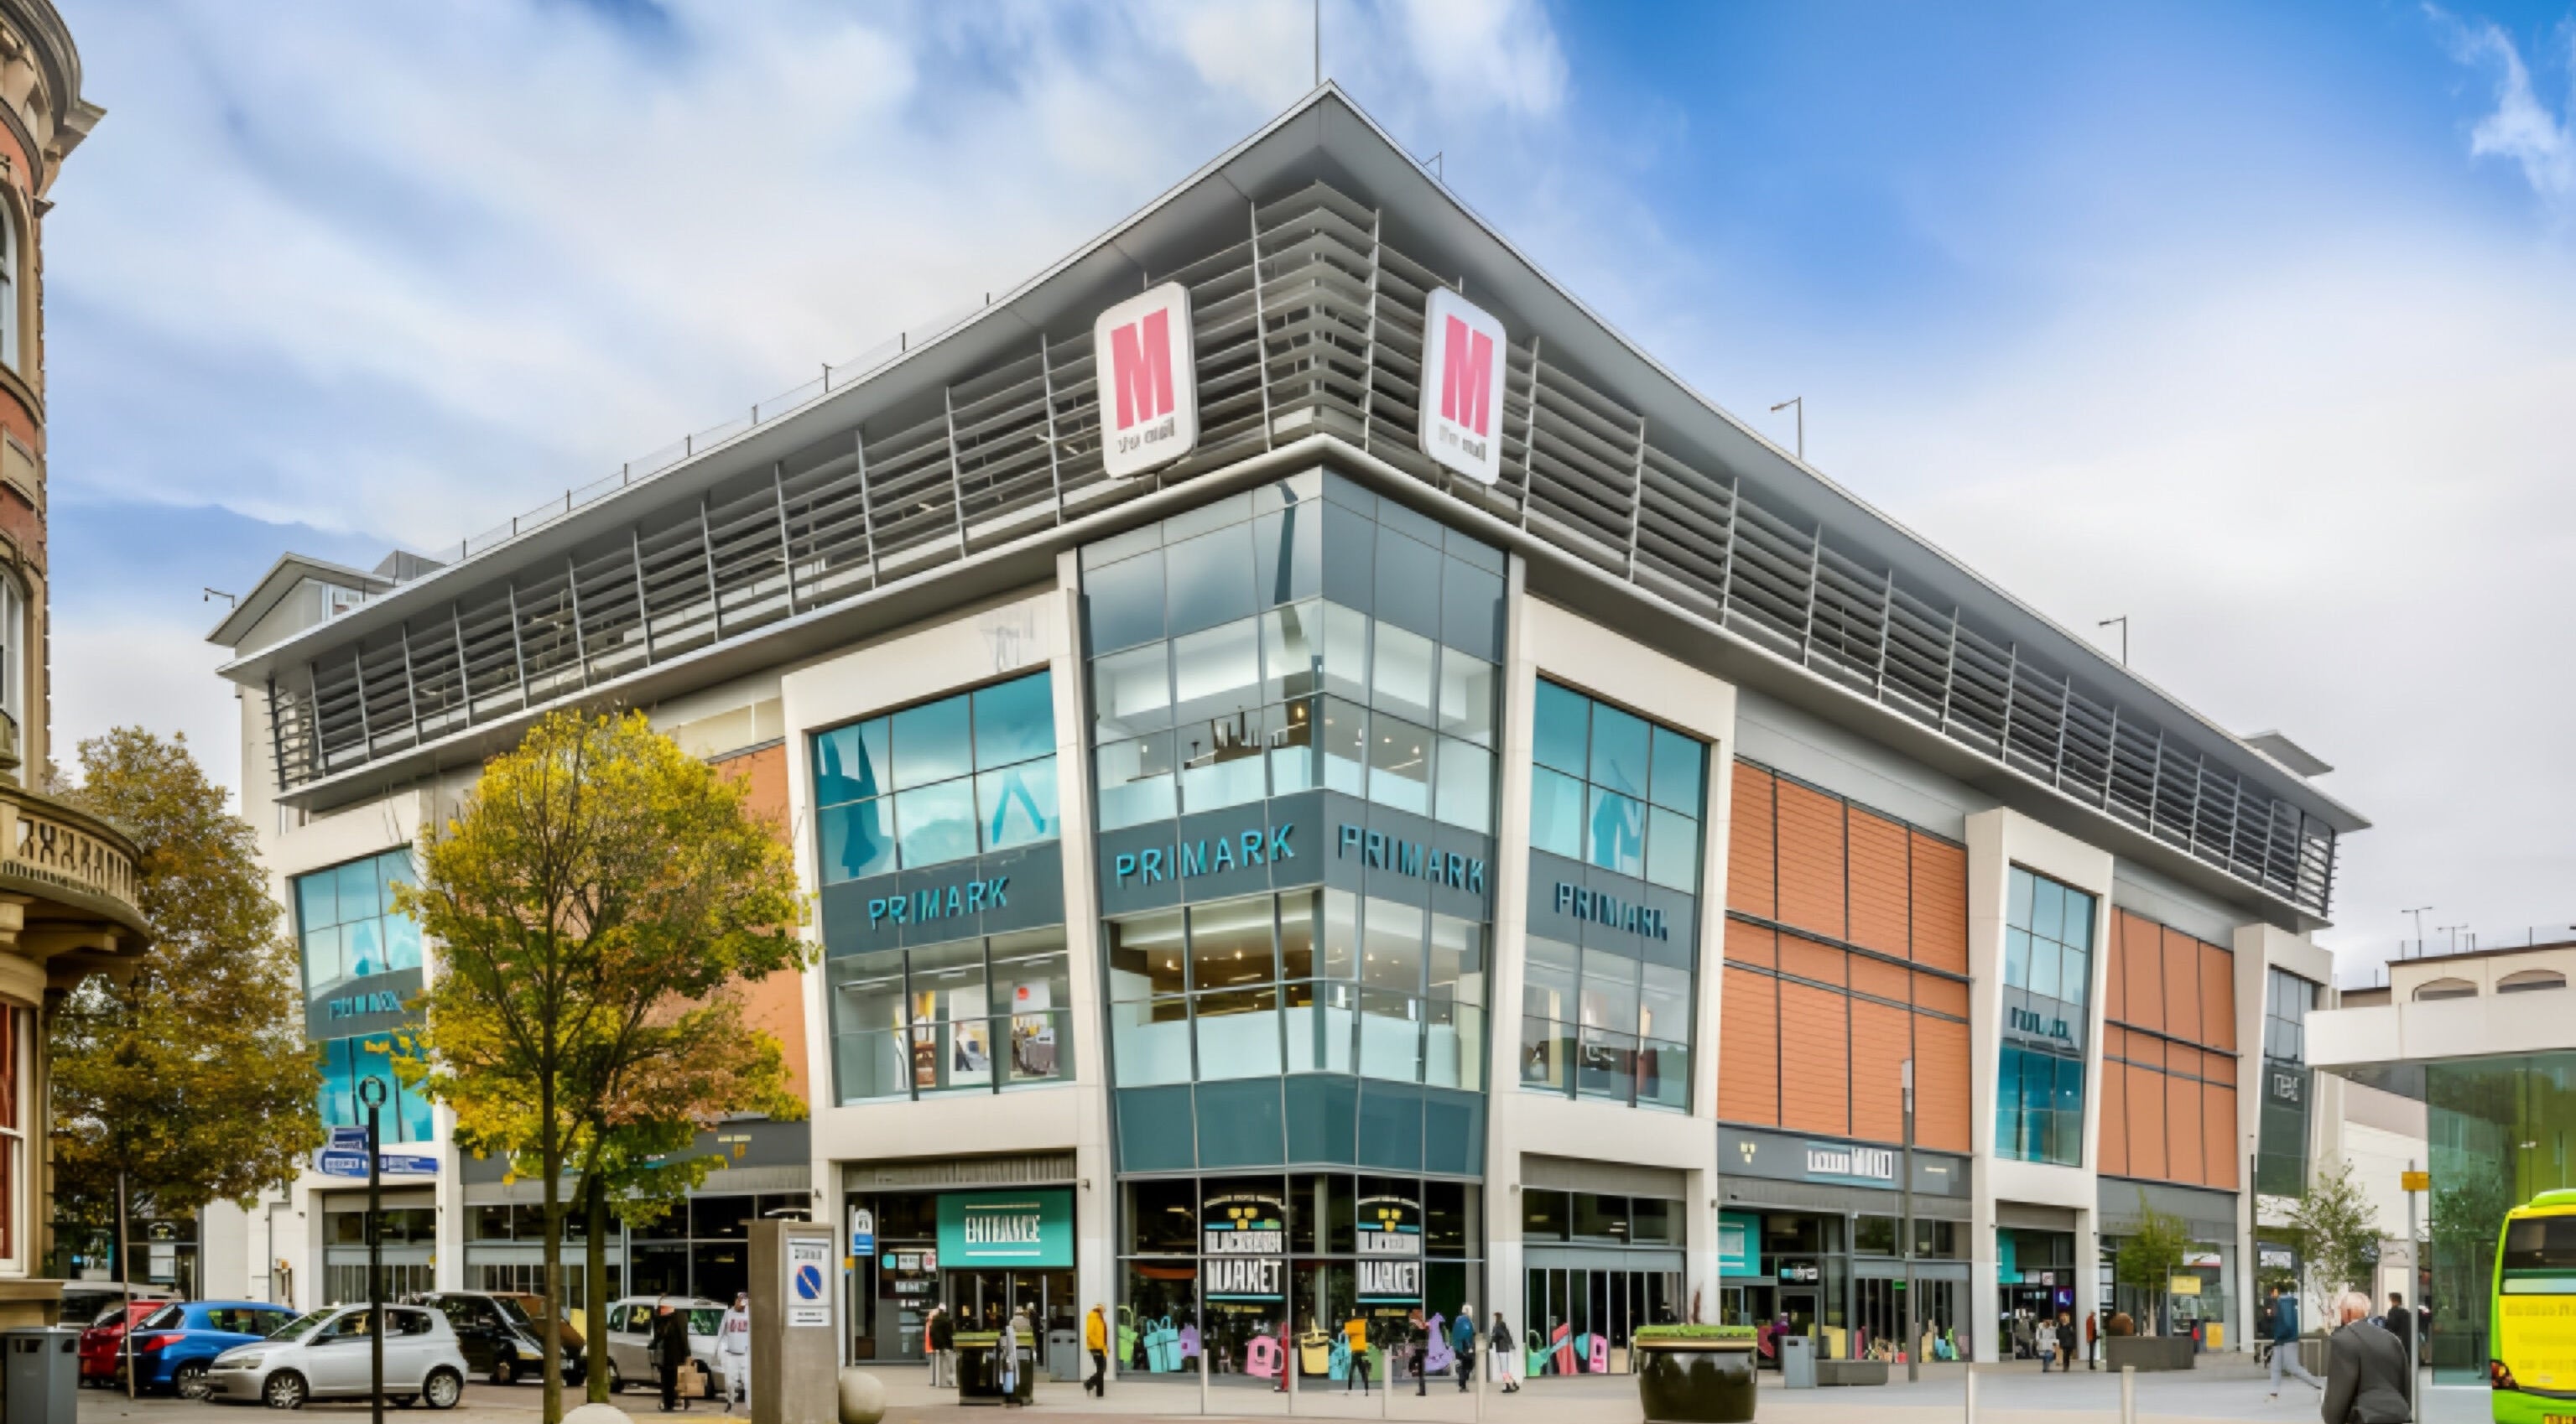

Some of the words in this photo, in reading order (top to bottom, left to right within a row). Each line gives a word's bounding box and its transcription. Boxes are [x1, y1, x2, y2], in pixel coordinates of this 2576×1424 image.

[1111, 307, 1174, 430] M
[1441, 314, 1493, 438] M
[1116, 822, 1297, 889] PRIMARK
[1338, 824, 1485, 894] PRIMARK
[867, 876, 1008, 931] PRIMARK
